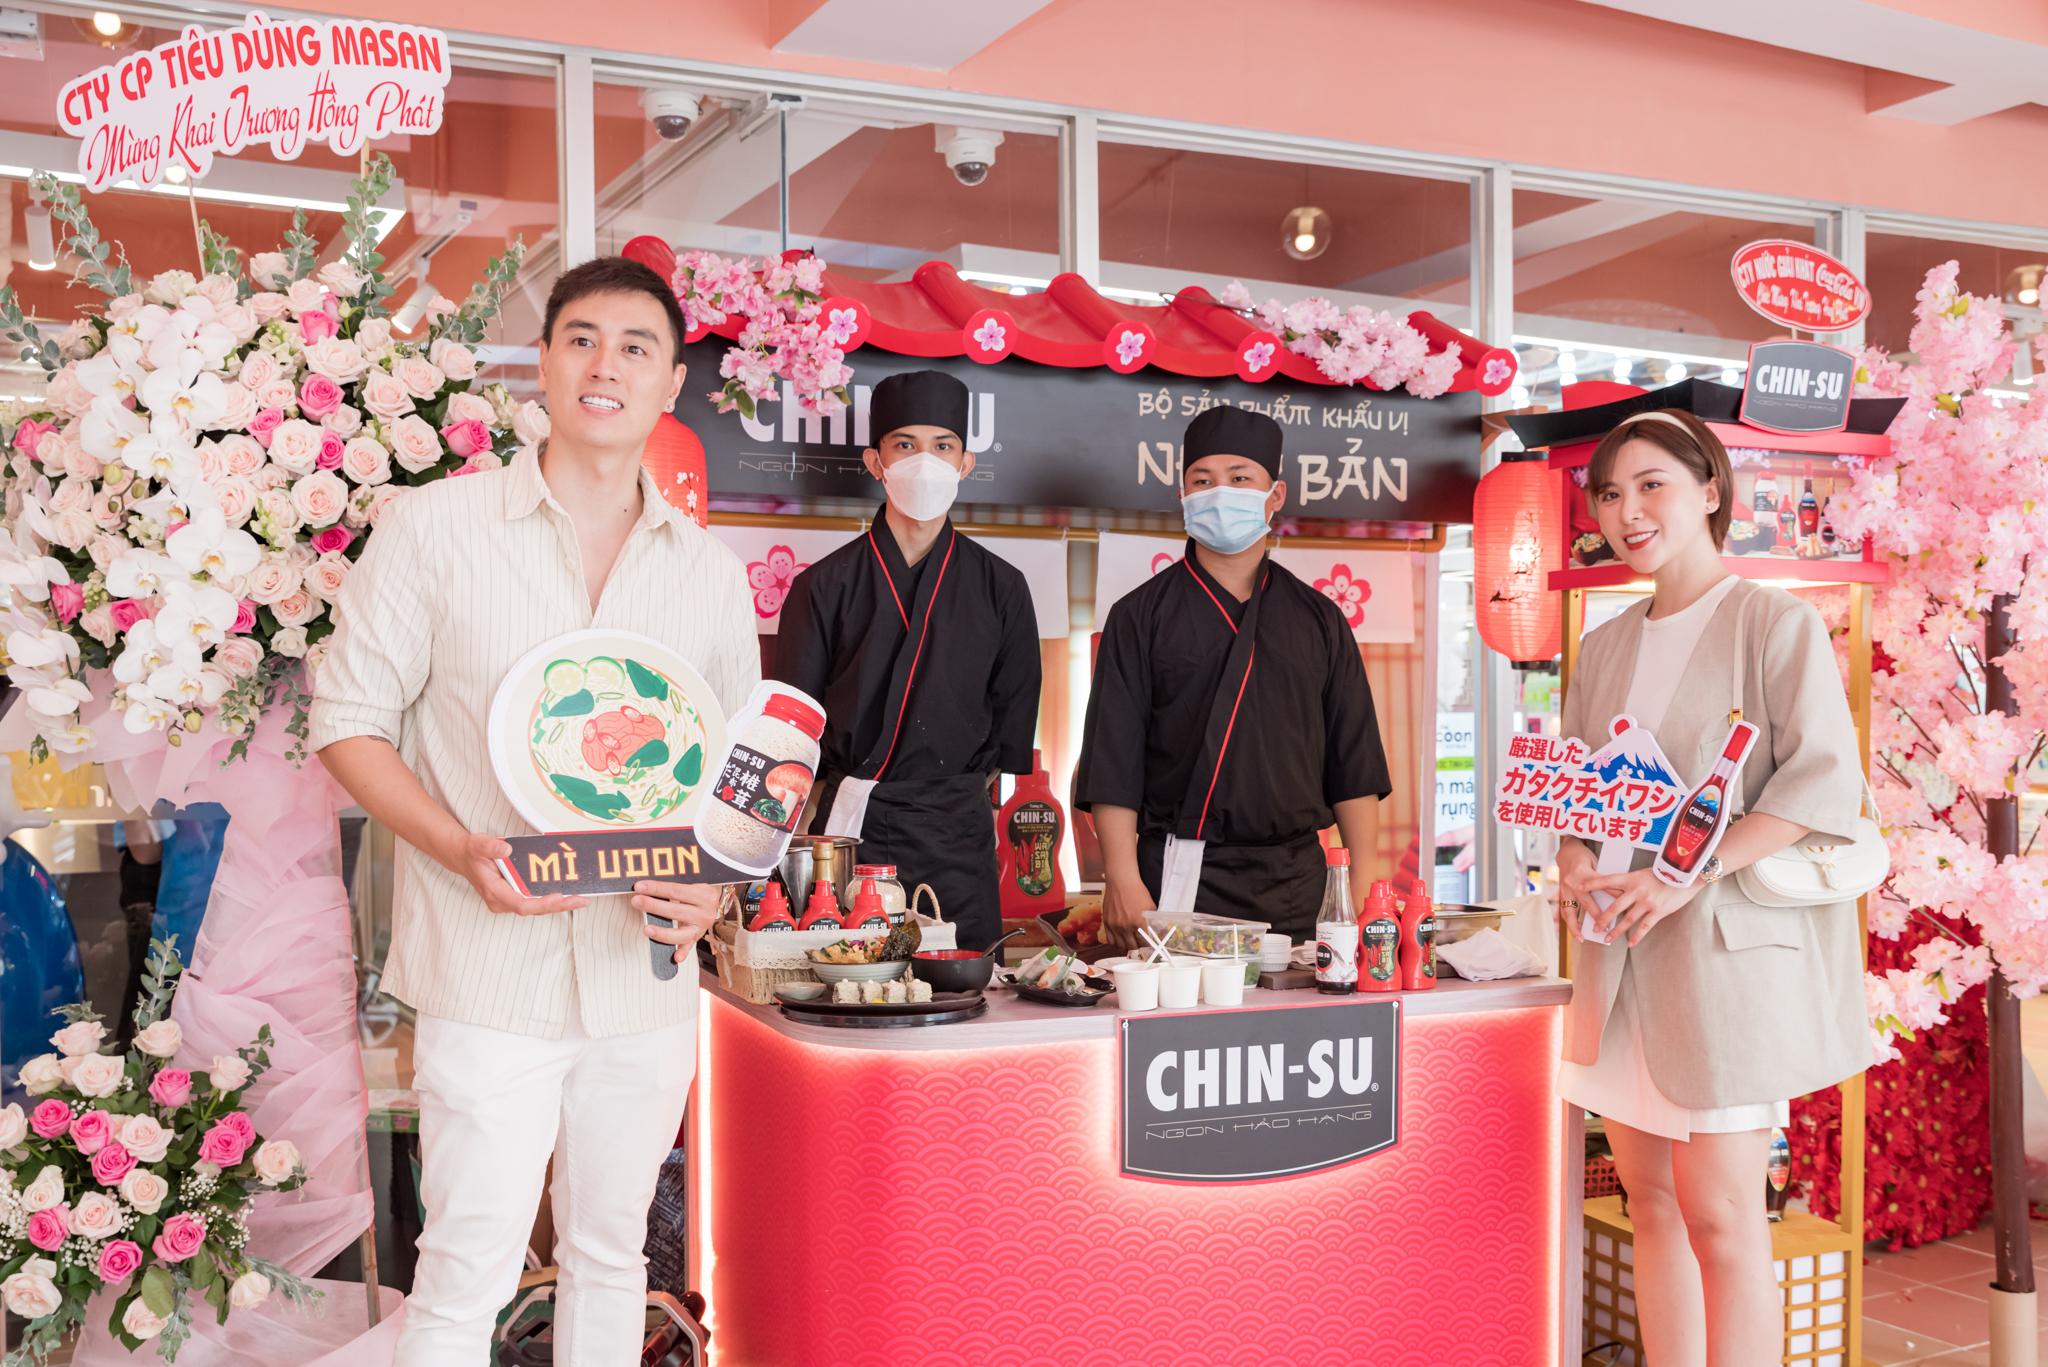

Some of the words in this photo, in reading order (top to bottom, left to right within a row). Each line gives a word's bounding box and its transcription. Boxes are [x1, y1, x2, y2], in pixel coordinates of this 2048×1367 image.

[64, 72, 110, 126] CTY
[120, 57, 153, 101] CP
[160, 28, 224, 89] TIÊU
[231, 15, 321, 73] DÙNG
[332, 25, 442, 74] MASAN
[87, 124, 160, 186] Mừng
[169, 94, 216, 174] Khai
[223, 84, 300, 154] Trương
[308, 69, 359, 150] Hồng
[366, 81, 435, 132] Phát
[1756, 364, 1844, 400] CHIN-SU
[1138, 387, 1173, 420] BỘ
[1323, 400, 1382, 431] KHẨU
[1388, 411, 1409, 436] VỊ
[739, 459, 828, 474] NGON
[1298, 437, 1408, 506] BẢN
[731, 747, 766, 770] CHIN-SU
[1508, 735, 1584, 765] 厳選した
[1502, 767, 1676, 816] カタクチイワシ
[1013, 811, 1055, 824] CHIN-SU
[1497, 800, 1648, 842] を使用しています
[1688, 806, 1715, 825] CHIN-SU
[528, 841, 579, 882] MÌ
[597, 845, 701, 879] UDON
[1365, 925, 1397, 934] CHIN-SU
[1146, 1036, 1374, 1112] CHIN-SU
[1146, 1125, 1224, 1140] NGON
[1233, 1117, 1290, 1131] HẢO
[1297, 1111, 1372, 1125] HẠNG
